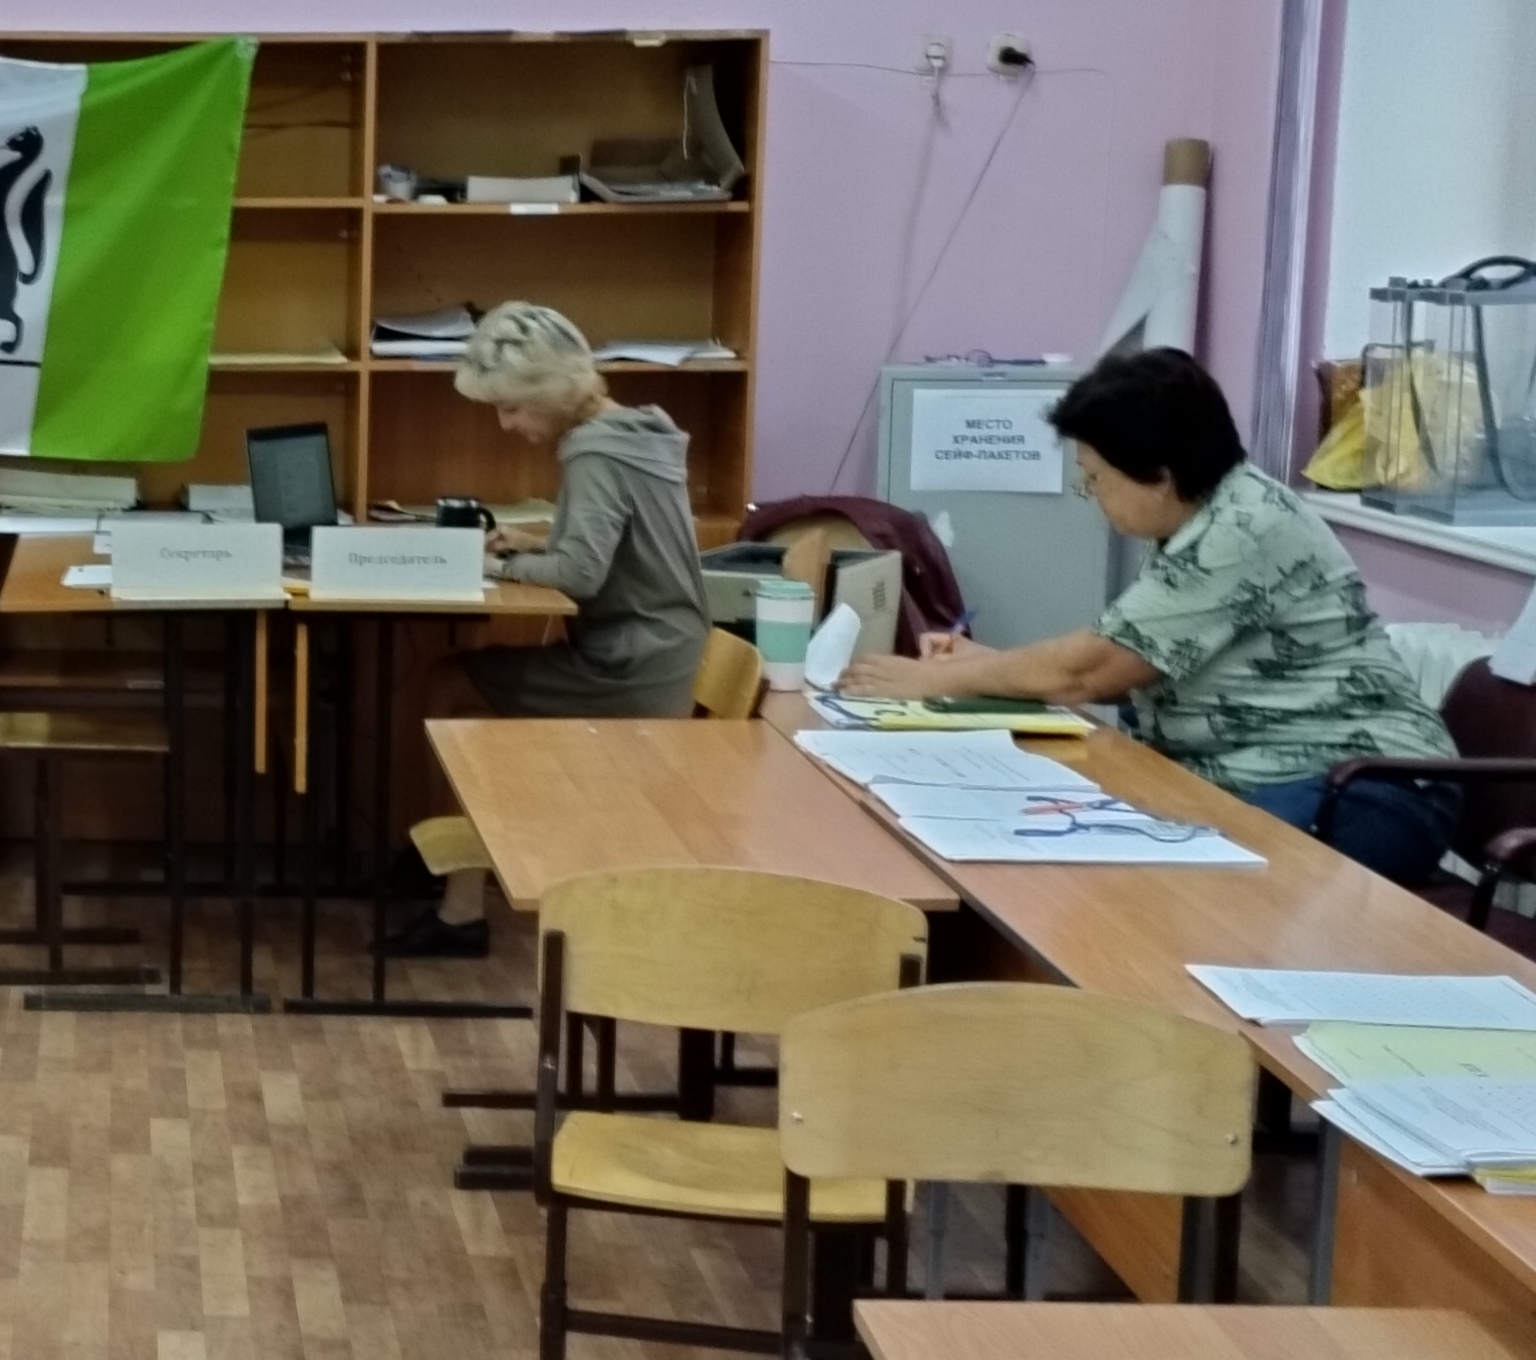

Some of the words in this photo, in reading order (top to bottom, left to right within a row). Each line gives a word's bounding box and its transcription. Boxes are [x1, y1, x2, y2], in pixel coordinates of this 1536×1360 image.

[964, 418, 1014, 430] МЕСТО
[952, 434, 1026, 446] ХРАНЕНИЯ
[934, 447, 1042, 461] СЕЙФ-ПАКЕТОВ
[159, 546, 233, 562] Секретарь
[348, 551, 448, 567] Председатель
